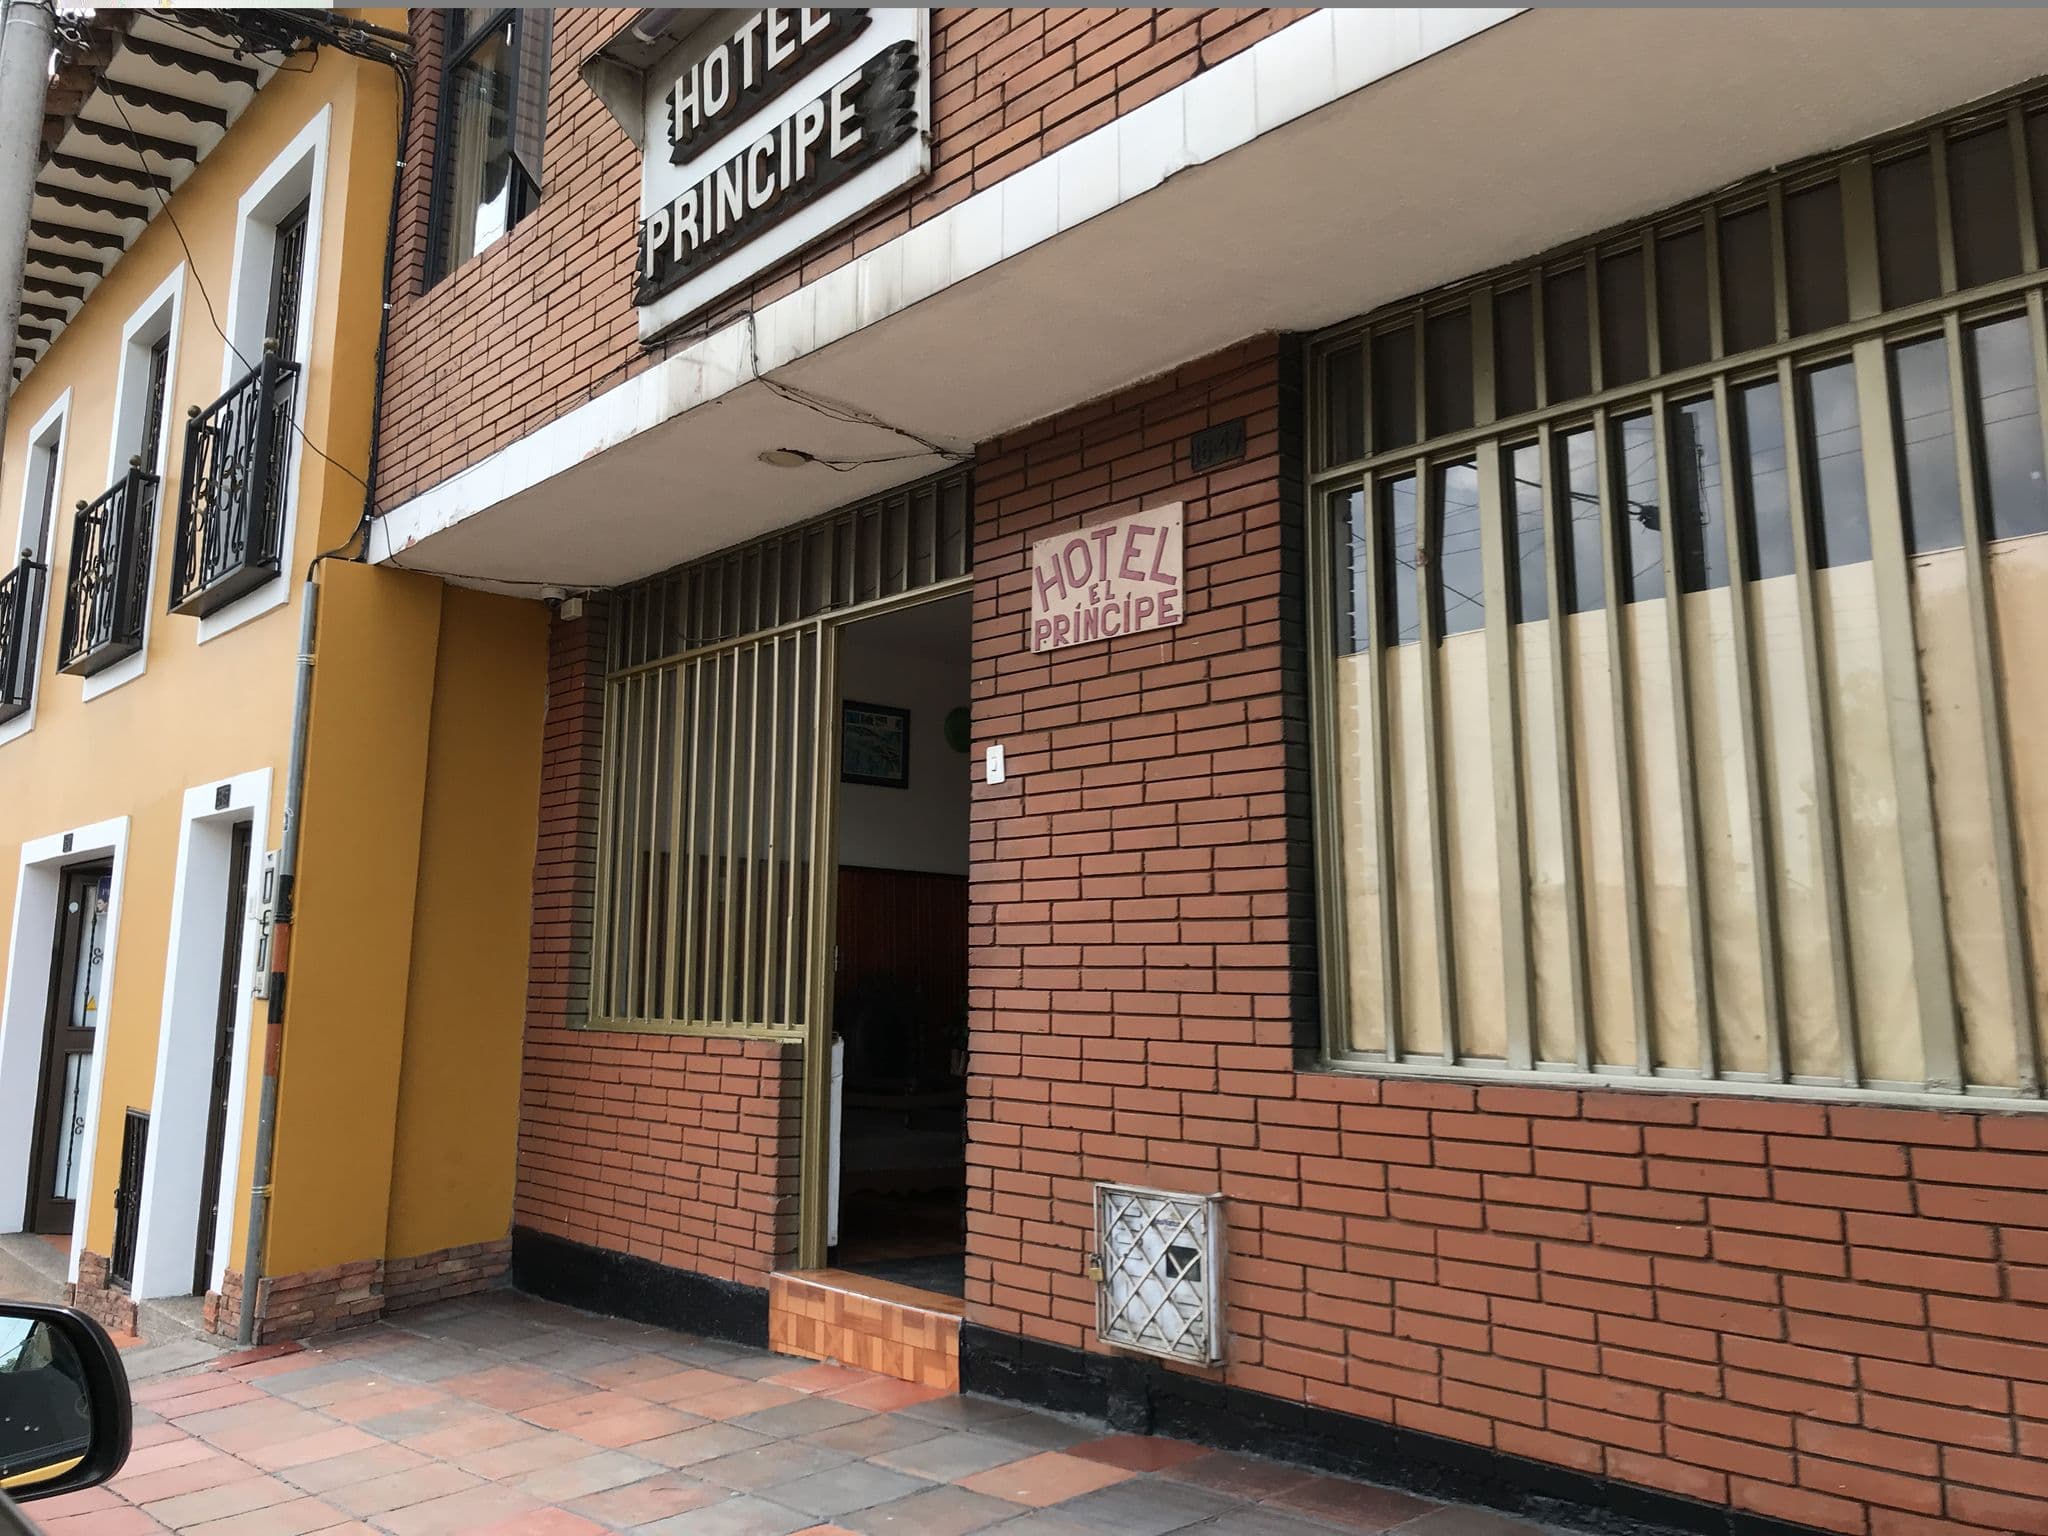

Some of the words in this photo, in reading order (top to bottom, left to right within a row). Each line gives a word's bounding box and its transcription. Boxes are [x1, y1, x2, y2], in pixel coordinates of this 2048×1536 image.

[646, 68, 864, 281] PRINCIPE
[1035, 524, 1177, 612] HOTEL
[1088, 579, 1116, 605] EL
